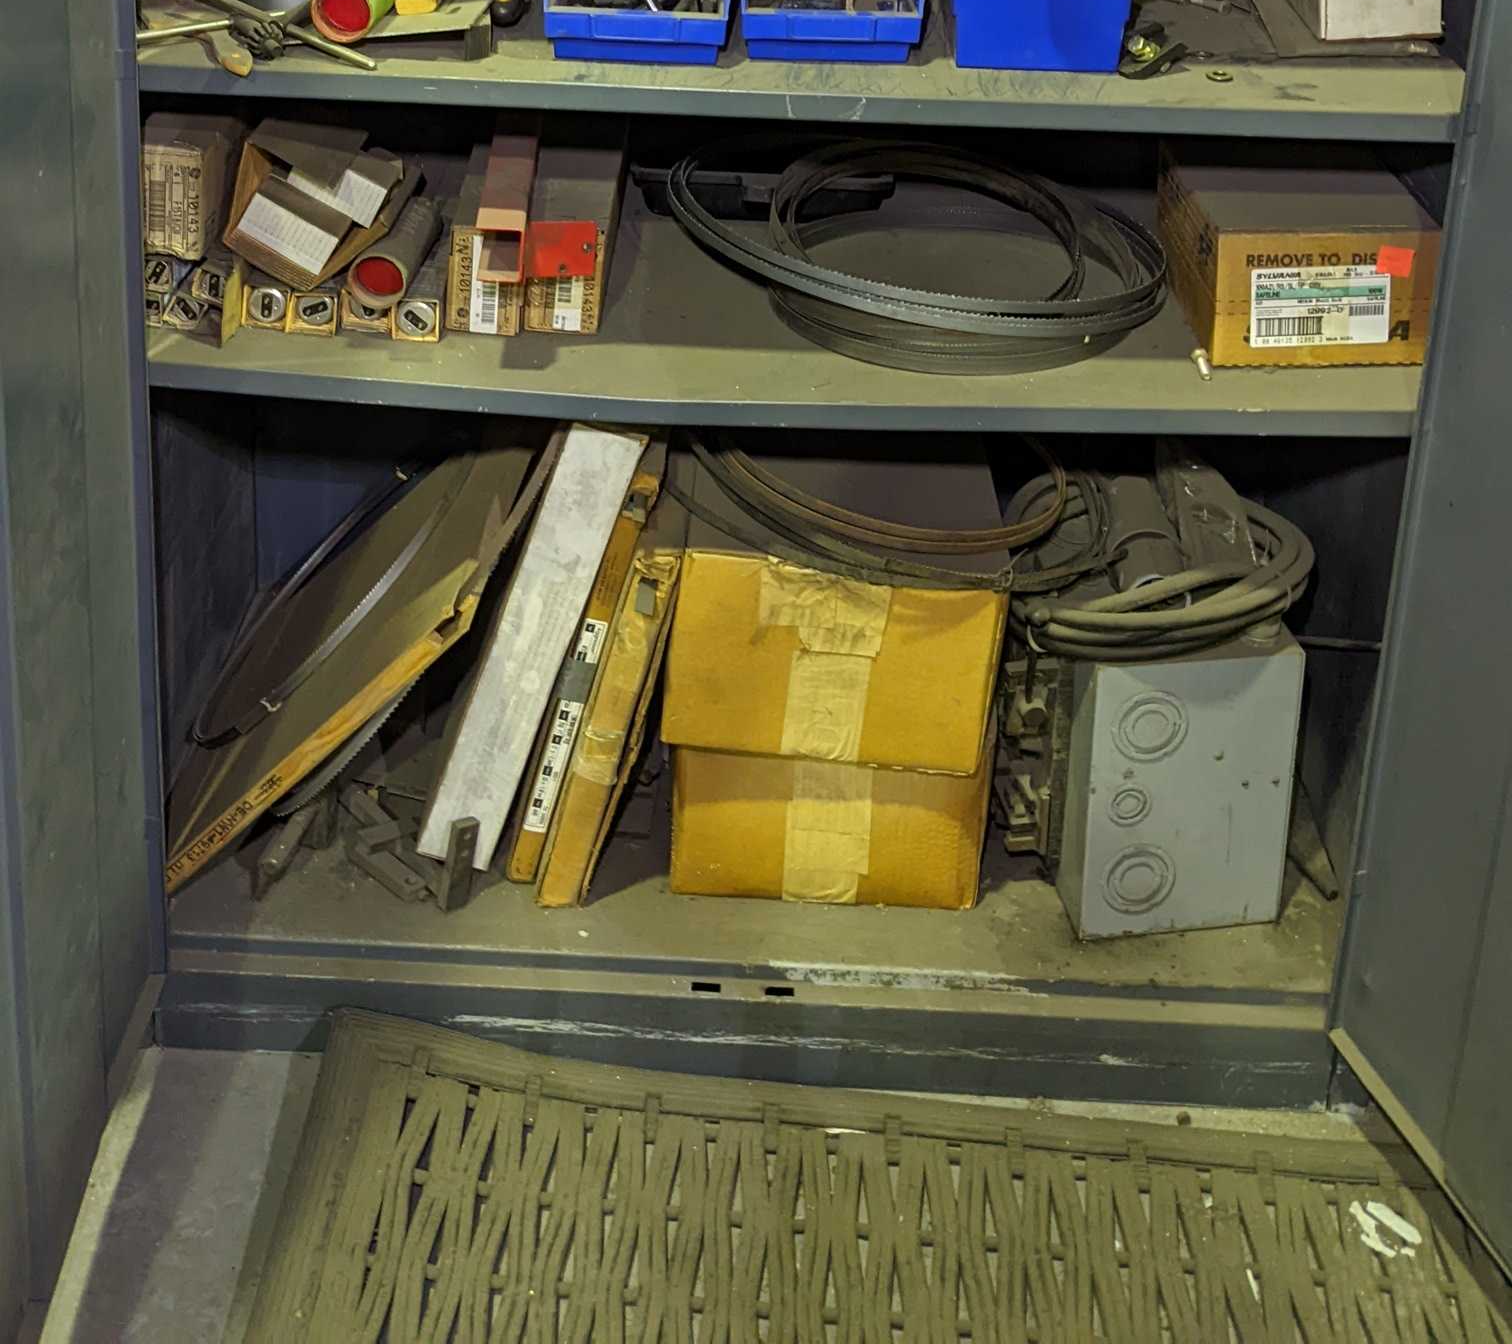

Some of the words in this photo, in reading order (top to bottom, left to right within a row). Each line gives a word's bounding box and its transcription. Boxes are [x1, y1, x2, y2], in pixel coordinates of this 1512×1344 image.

[1246, 254, 1314, 267] REMOVE
[1320, 253, 1341, 266] TO
[1352, 253, 1377, 265] DIS
